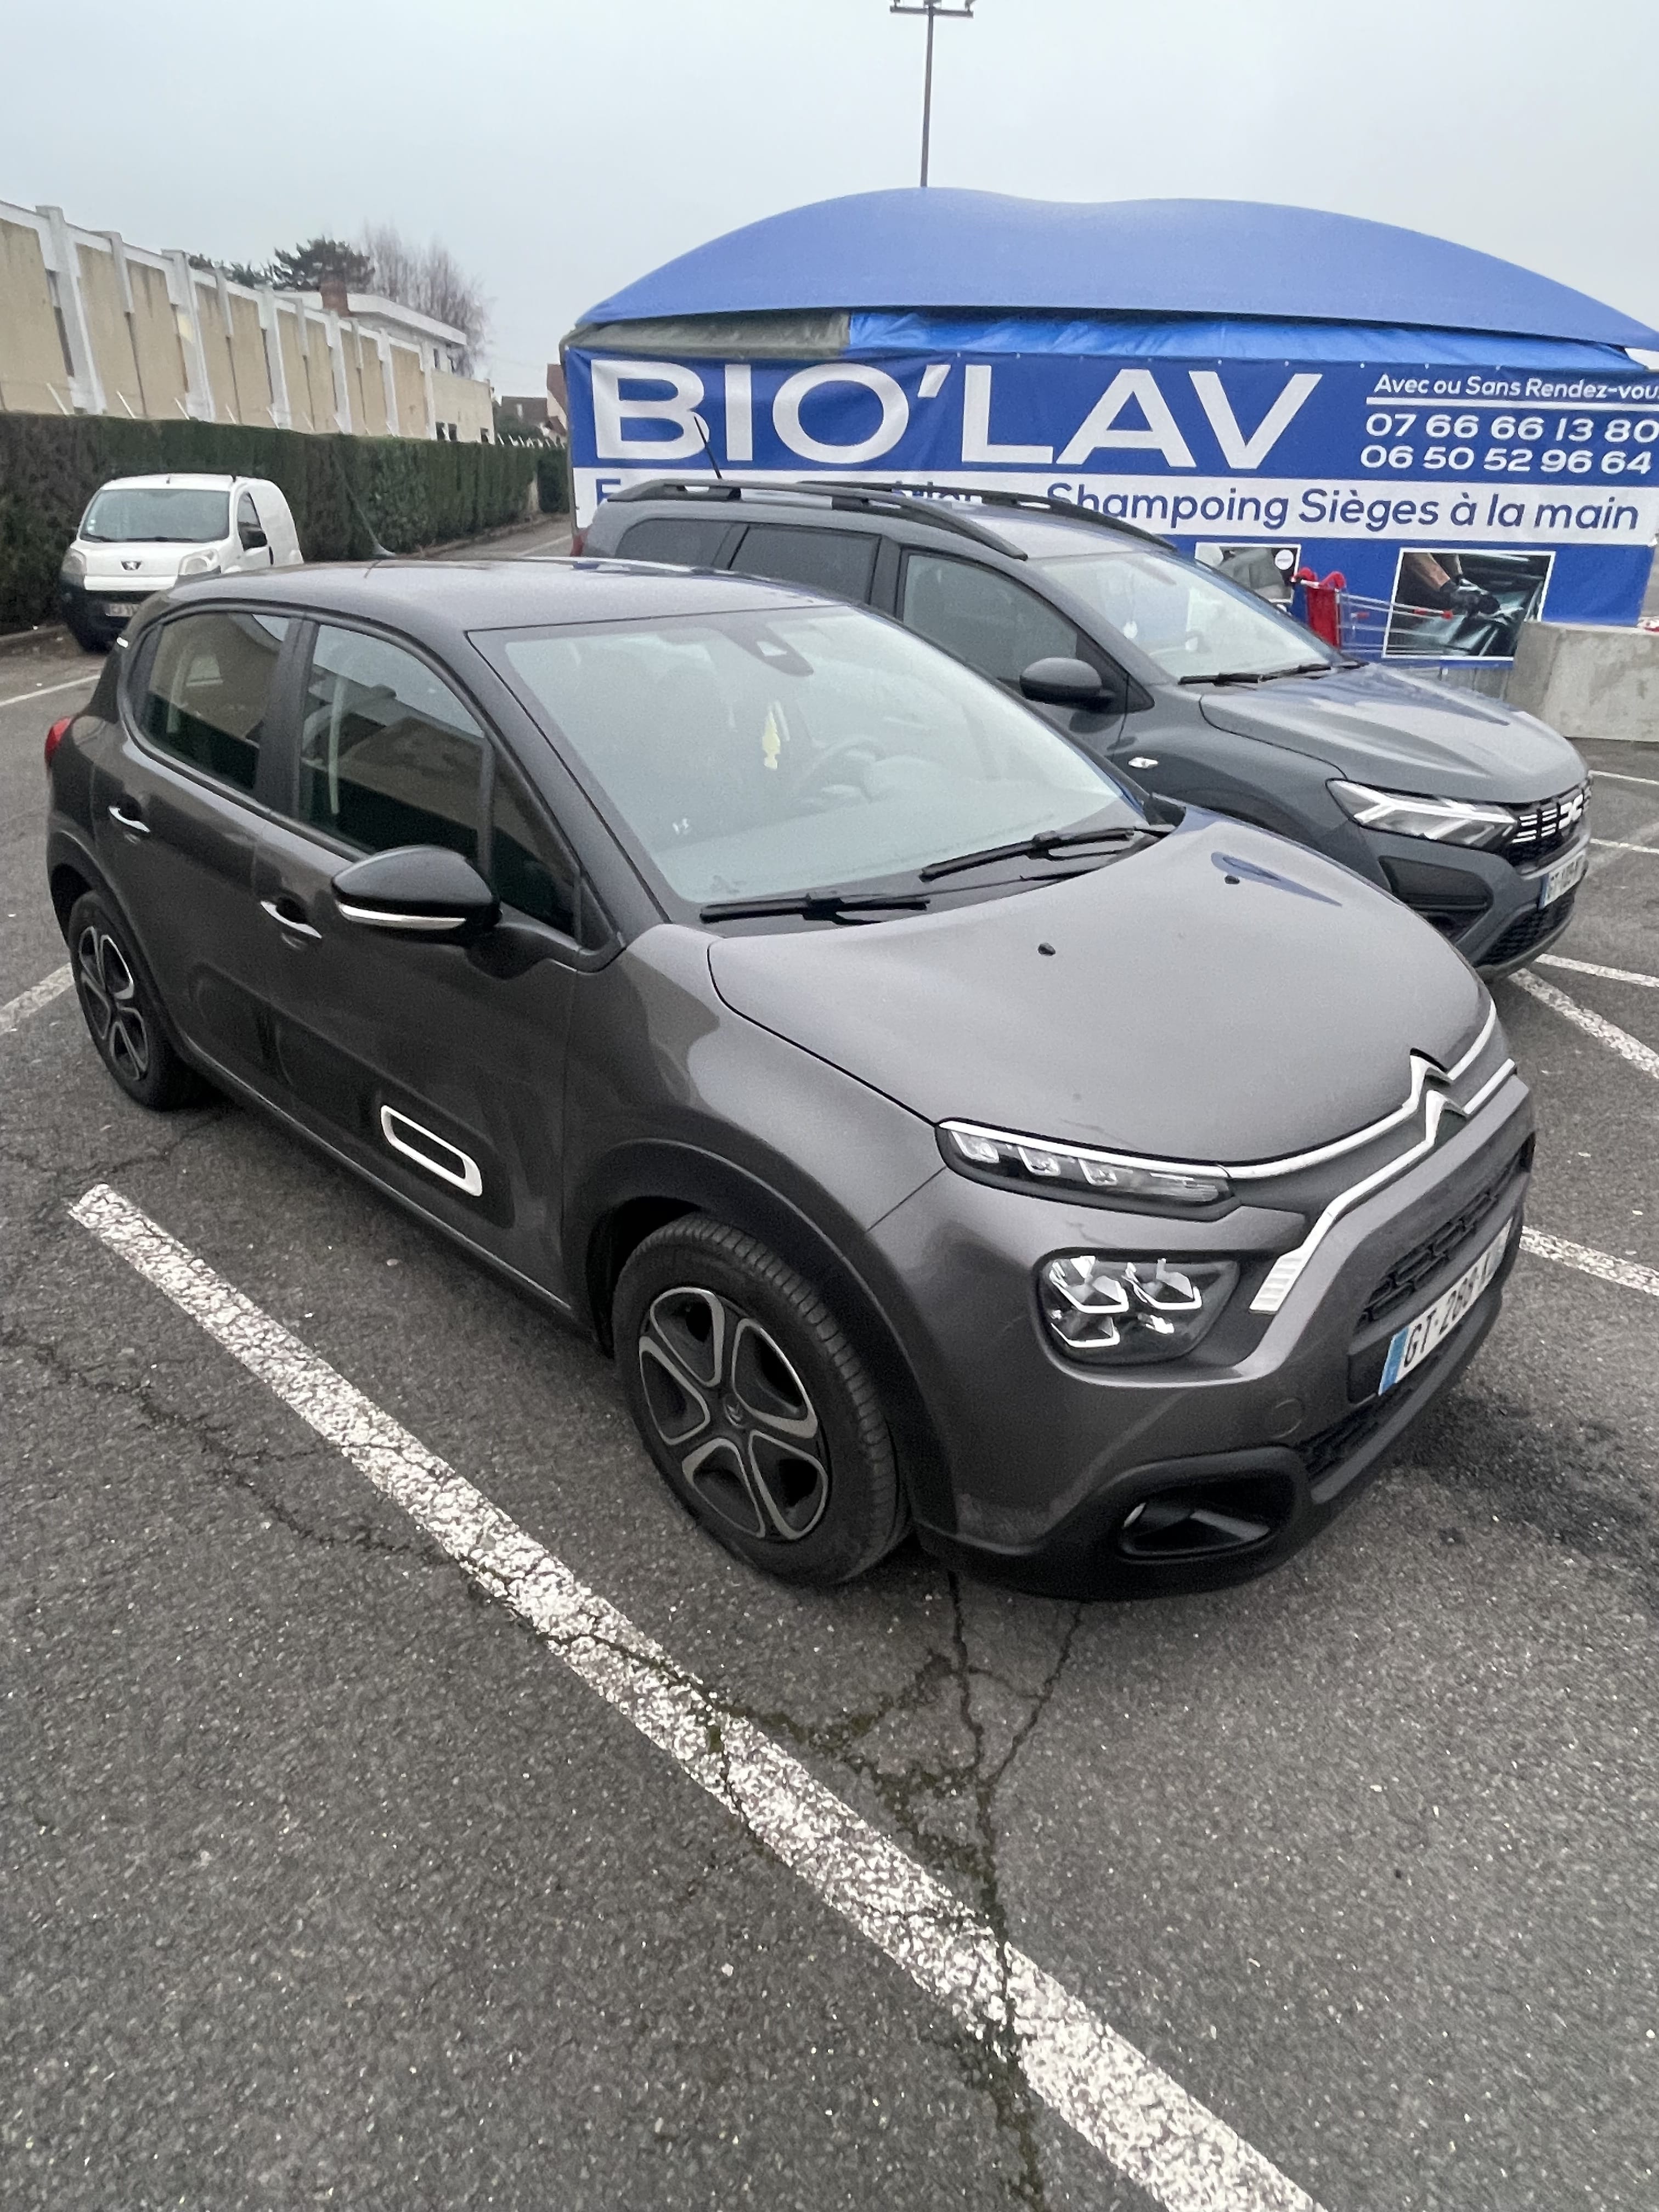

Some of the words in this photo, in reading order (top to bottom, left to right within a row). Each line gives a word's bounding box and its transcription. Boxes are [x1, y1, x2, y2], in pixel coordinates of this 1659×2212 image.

[1374, 374, 1429, 393] Avec
[1433, 379, 1461, 395] ou
[1465, 375, 1521, 396] Sans
[1525, 377, 1659, 400] Rendez-vou
[1365, 413, 1417, 437] 07
[1425, 414, 1480, 439] 66
[1491, 416, 1544, 440] 66
[1555, 417, 1594, 442] 13
[1604, 419, 1659, 443] 80
[1360, 444, 1414, 469] 06
[1423, 447, 1475, 470] 50
[1483, 448, 1534, 472] 52
[1540, 449, 1593, 473] 96
[1600, 450, 1652, 475] 64
[1298, 488, 1440, 532] Sièges
[1450, 492, 1477, 526] à
[1487, 494, 1525, 528] la
[1534, 496, 1639, 530] main
